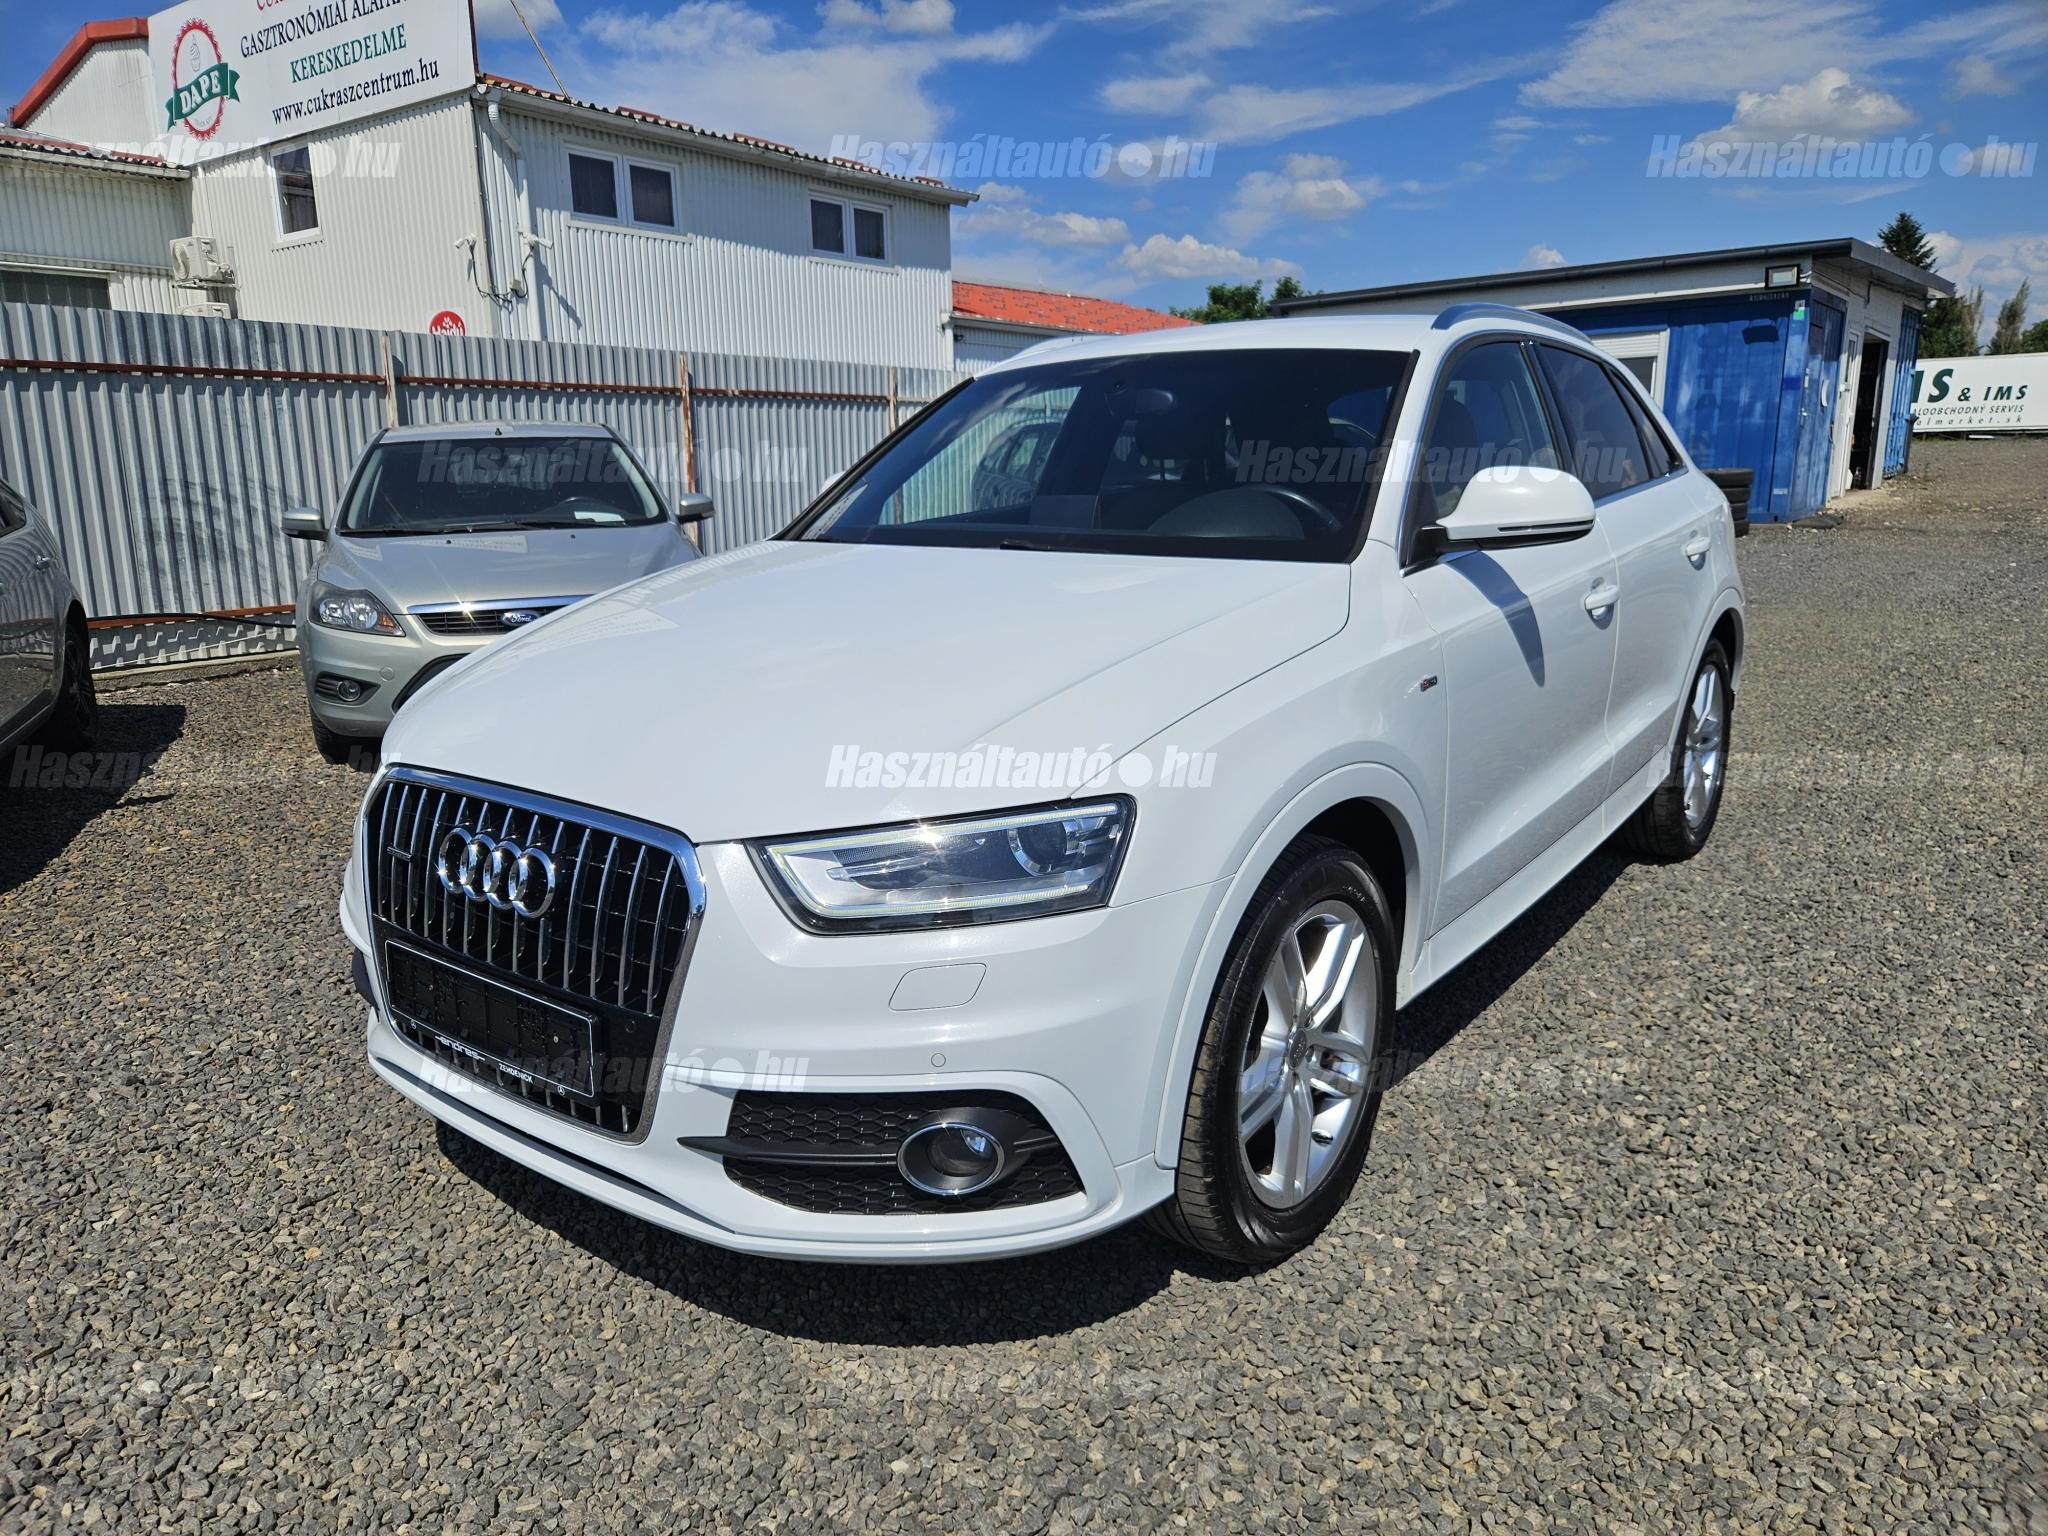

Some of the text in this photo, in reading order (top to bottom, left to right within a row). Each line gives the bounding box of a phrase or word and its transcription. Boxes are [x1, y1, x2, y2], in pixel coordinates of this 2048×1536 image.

[240, 0, 348, 58] GASZTRONÓMIAI
[289, 23, 407, 84] KERESKEDELME
[179, 69, 222, 115] DAPE
[272, 57, 440, 125] www.cukraszcentrum.hu
[1957, 387, 1971, 401] &
[1983, 385, 2028, 401] IMS
[1989, 404, 2025, 415] SERVIS
